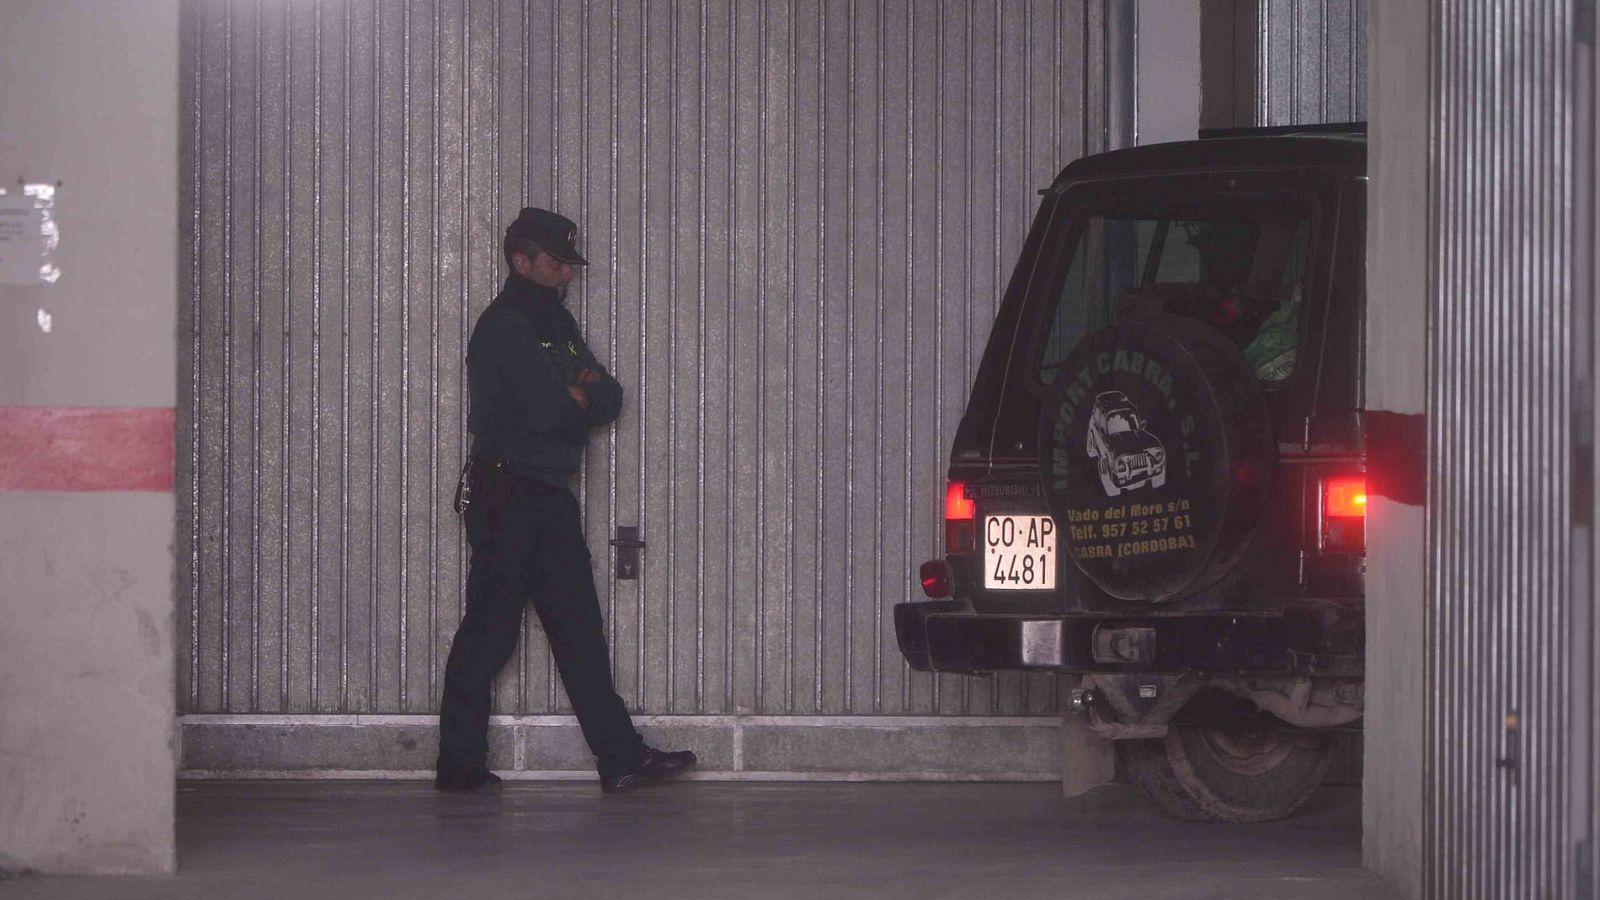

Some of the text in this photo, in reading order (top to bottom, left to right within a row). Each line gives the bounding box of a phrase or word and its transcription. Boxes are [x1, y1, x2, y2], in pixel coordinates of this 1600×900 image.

[1052, 366, 1093, 490] IMPORT
[981, 483, 1027, 497] MITSUBISHI
[1067, 497, 1190, 522] Vado del Moro s/n
[1070, 525, 1097, 540] Telf.
[1102, 522, 1127, 538] 957
[1132, 520, 1148, 535] 52
[1174, 514, 1191, 529] 61
[994, 554, 1046, 584] 4481
